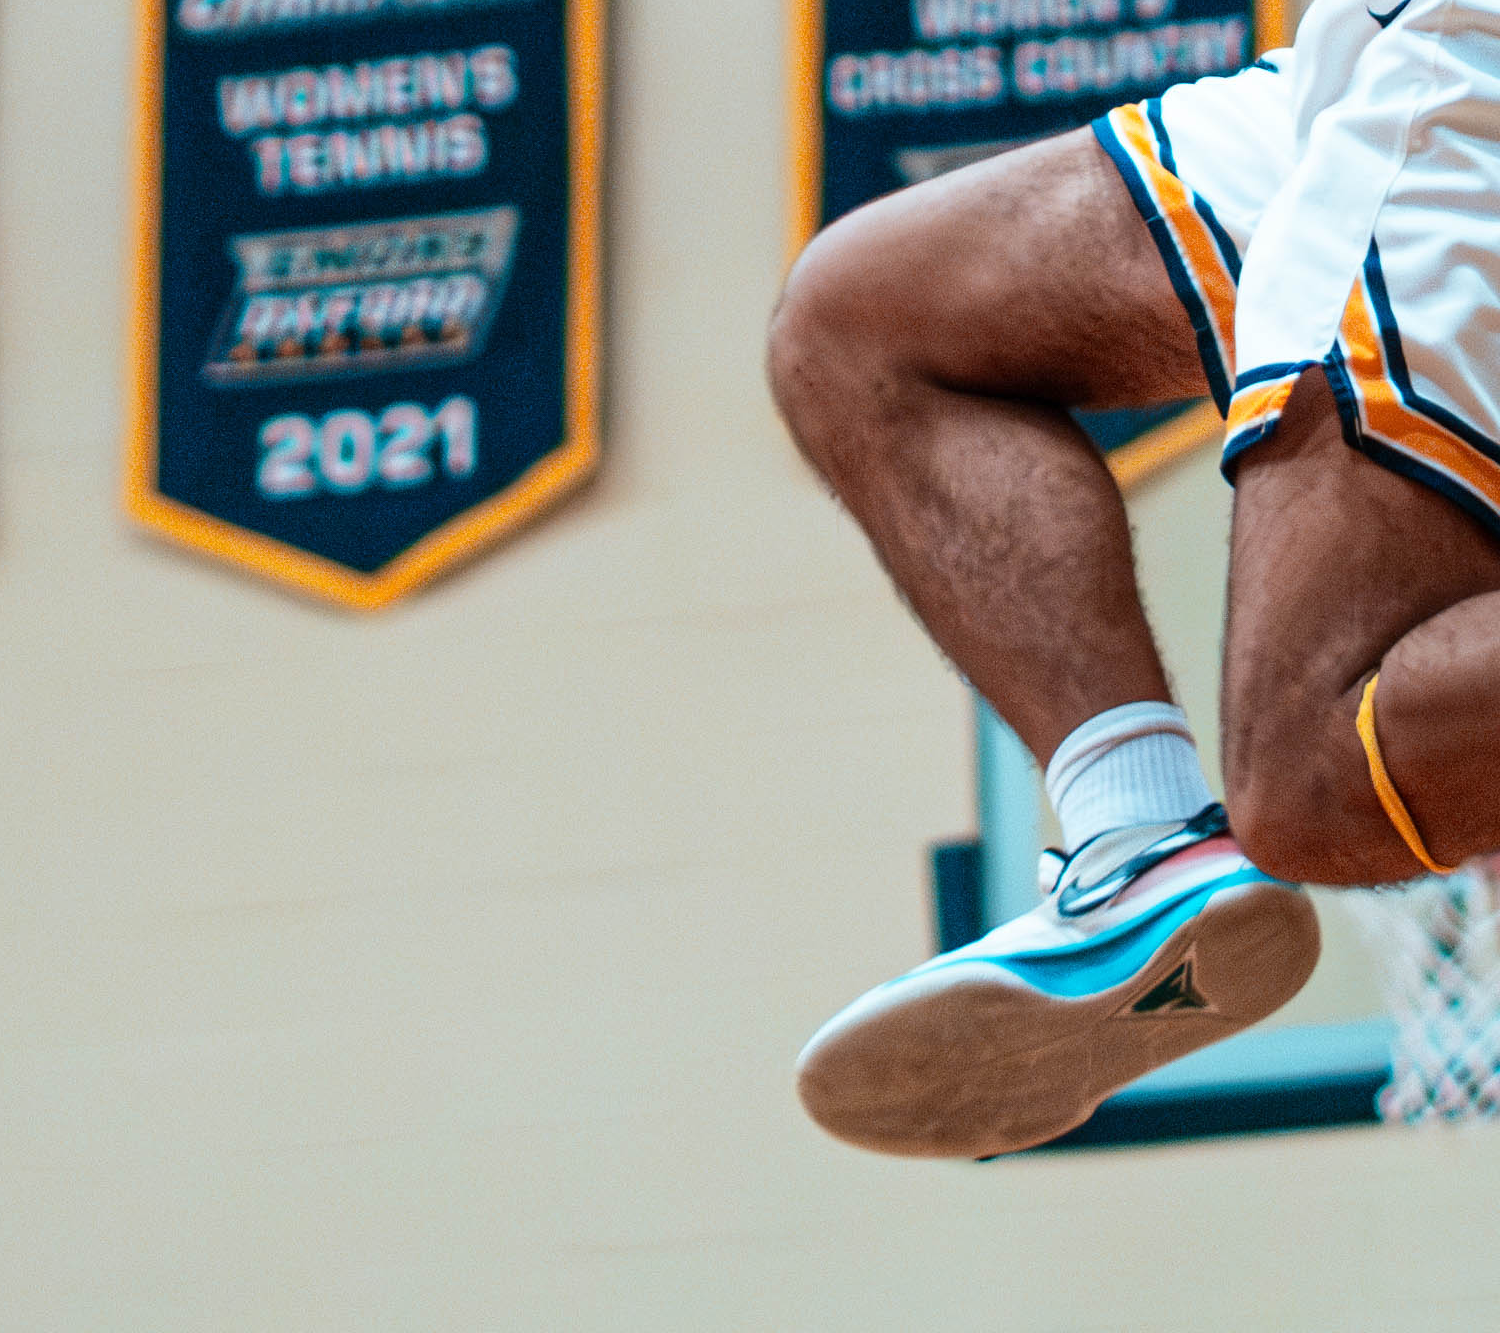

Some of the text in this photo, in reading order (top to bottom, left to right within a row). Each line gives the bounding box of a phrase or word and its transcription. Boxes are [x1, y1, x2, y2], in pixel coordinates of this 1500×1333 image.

[225, 51, 511, 126] WOMEN'S
[835, 23, 1241, 107] CROSS COUNTRY
[258, 120, 482, 191] TENNIS
[265, 401, 471, 494] 2021
